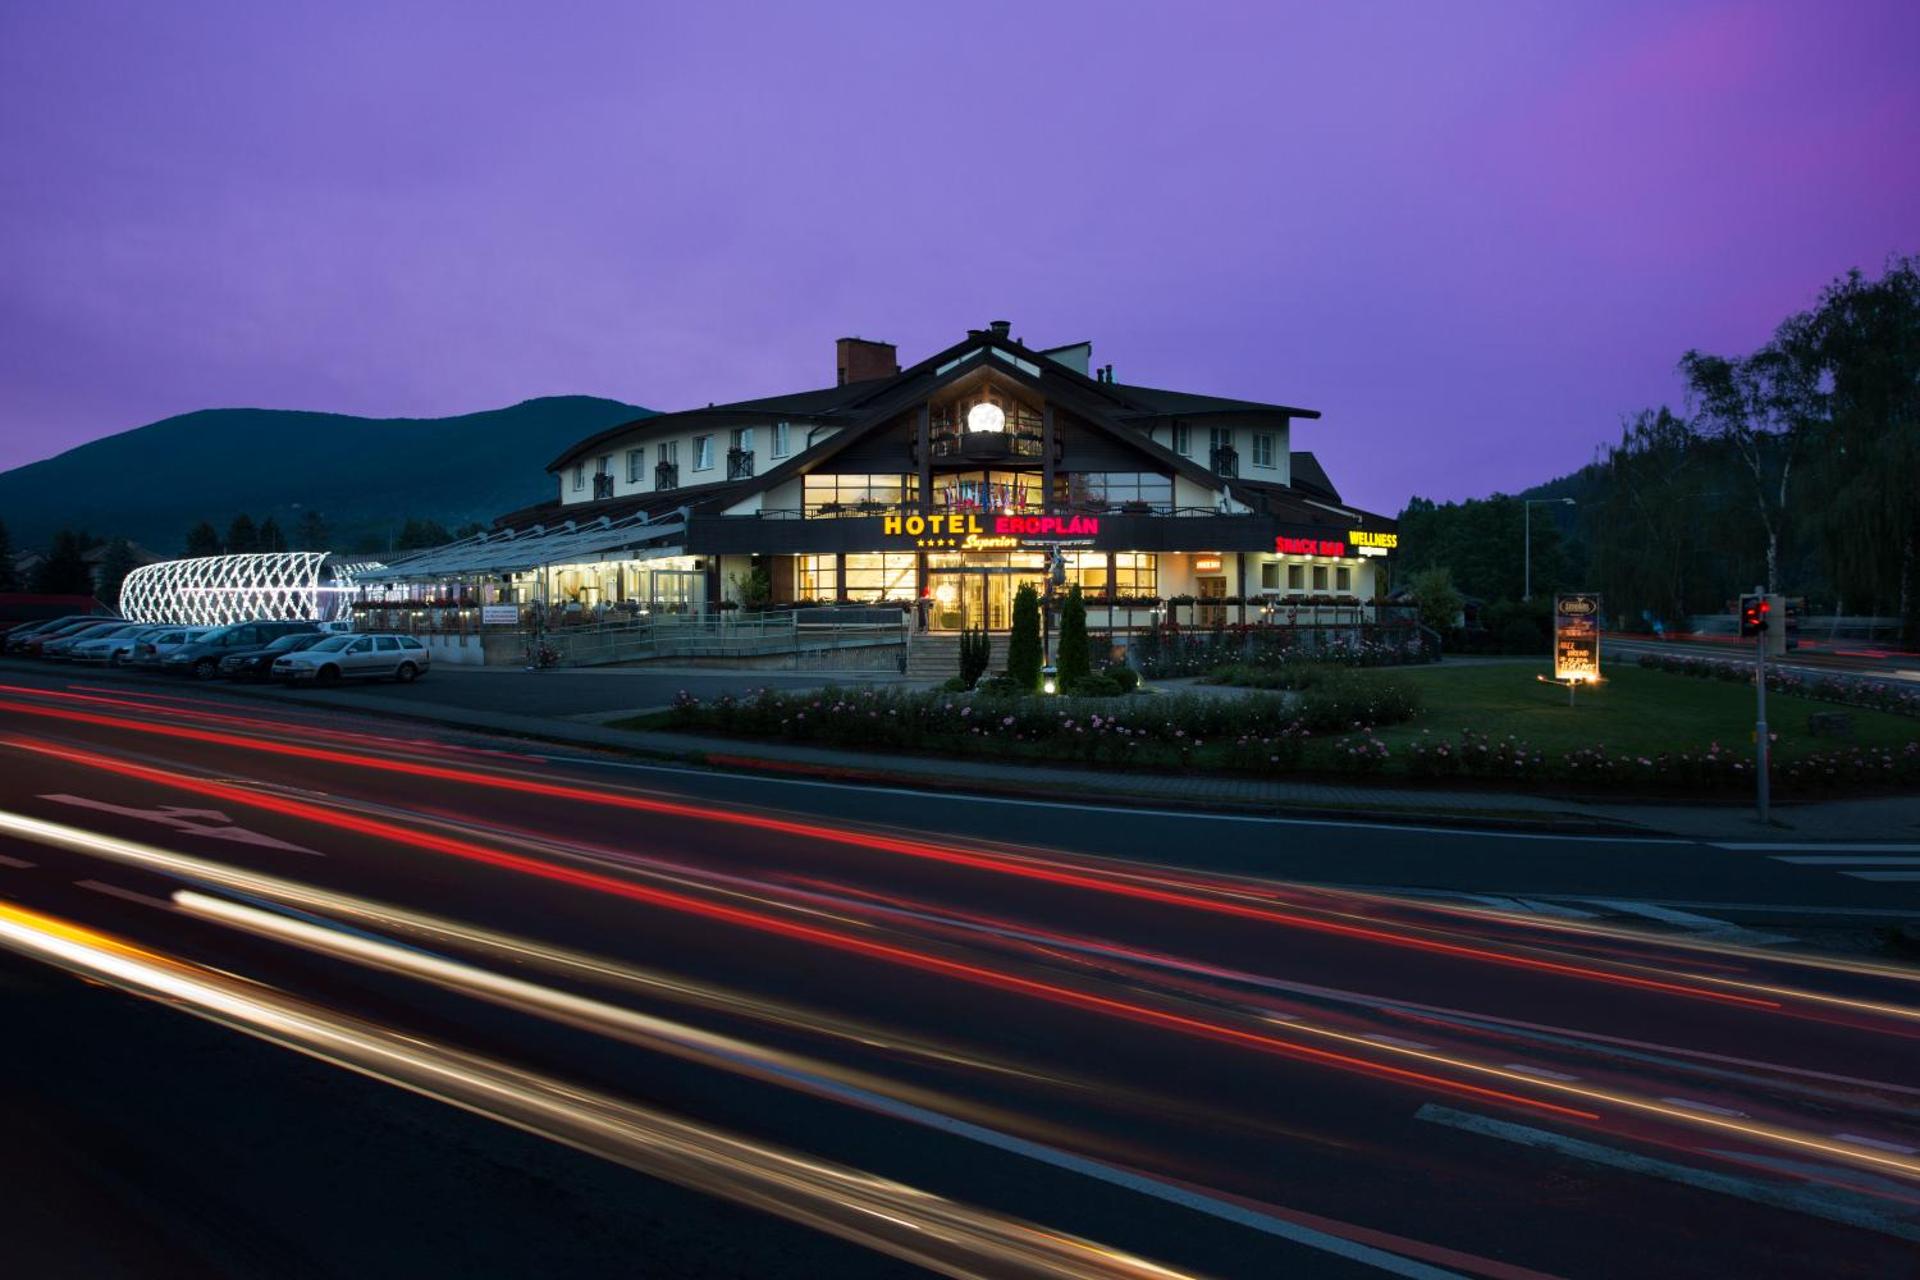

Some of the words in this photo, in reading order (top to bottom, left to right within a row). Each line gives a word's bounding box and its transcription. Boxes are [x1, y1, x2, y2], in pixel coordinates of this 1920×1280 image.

[884, 514, 984, 535] HOTEL
[994, 515, 1099, 535] EROPLÁN
[961, 534, 1017, 551] Superior
[1349, 530, 1398, 549] WELLNESS
